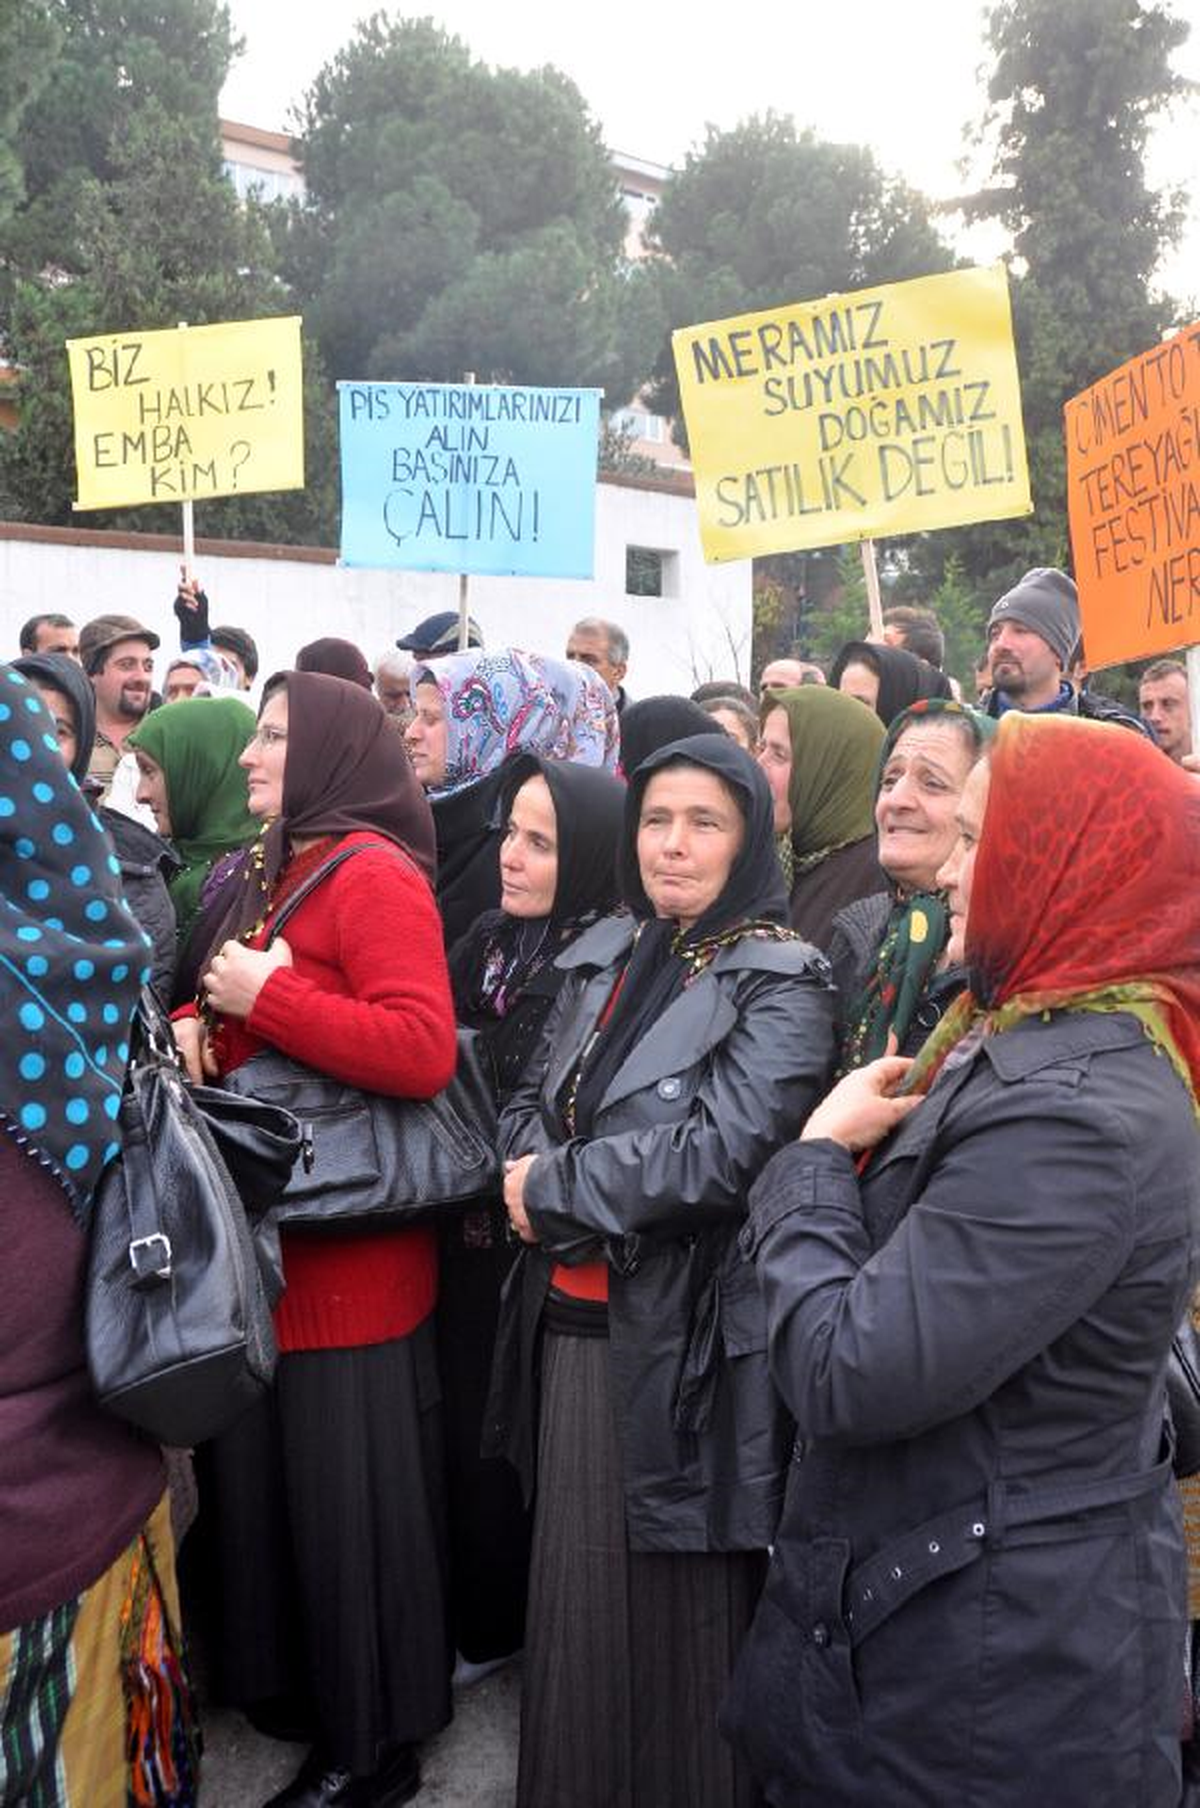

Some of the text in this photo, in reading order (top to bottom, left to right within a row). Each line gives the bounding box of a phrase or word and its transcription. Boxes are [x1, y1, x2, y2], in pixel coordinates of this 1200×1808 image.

[85, 339, 151, 392] BİZ
[691, 301, 889, 384] MERAMIZ
[350, 386, 582, 424] PİS YATIRIMLARINIZI
[763, 339, 962, 417] SUYUMUZ
[425, 425, 489, 451] ALIN
[818, 380, 997, 452] DOĞAMIZ
[94, 425, 193, 468] EMBA
[383, 488, 540, 548] ÇALIN!
[716, 453, 868, 527] SATILIK
